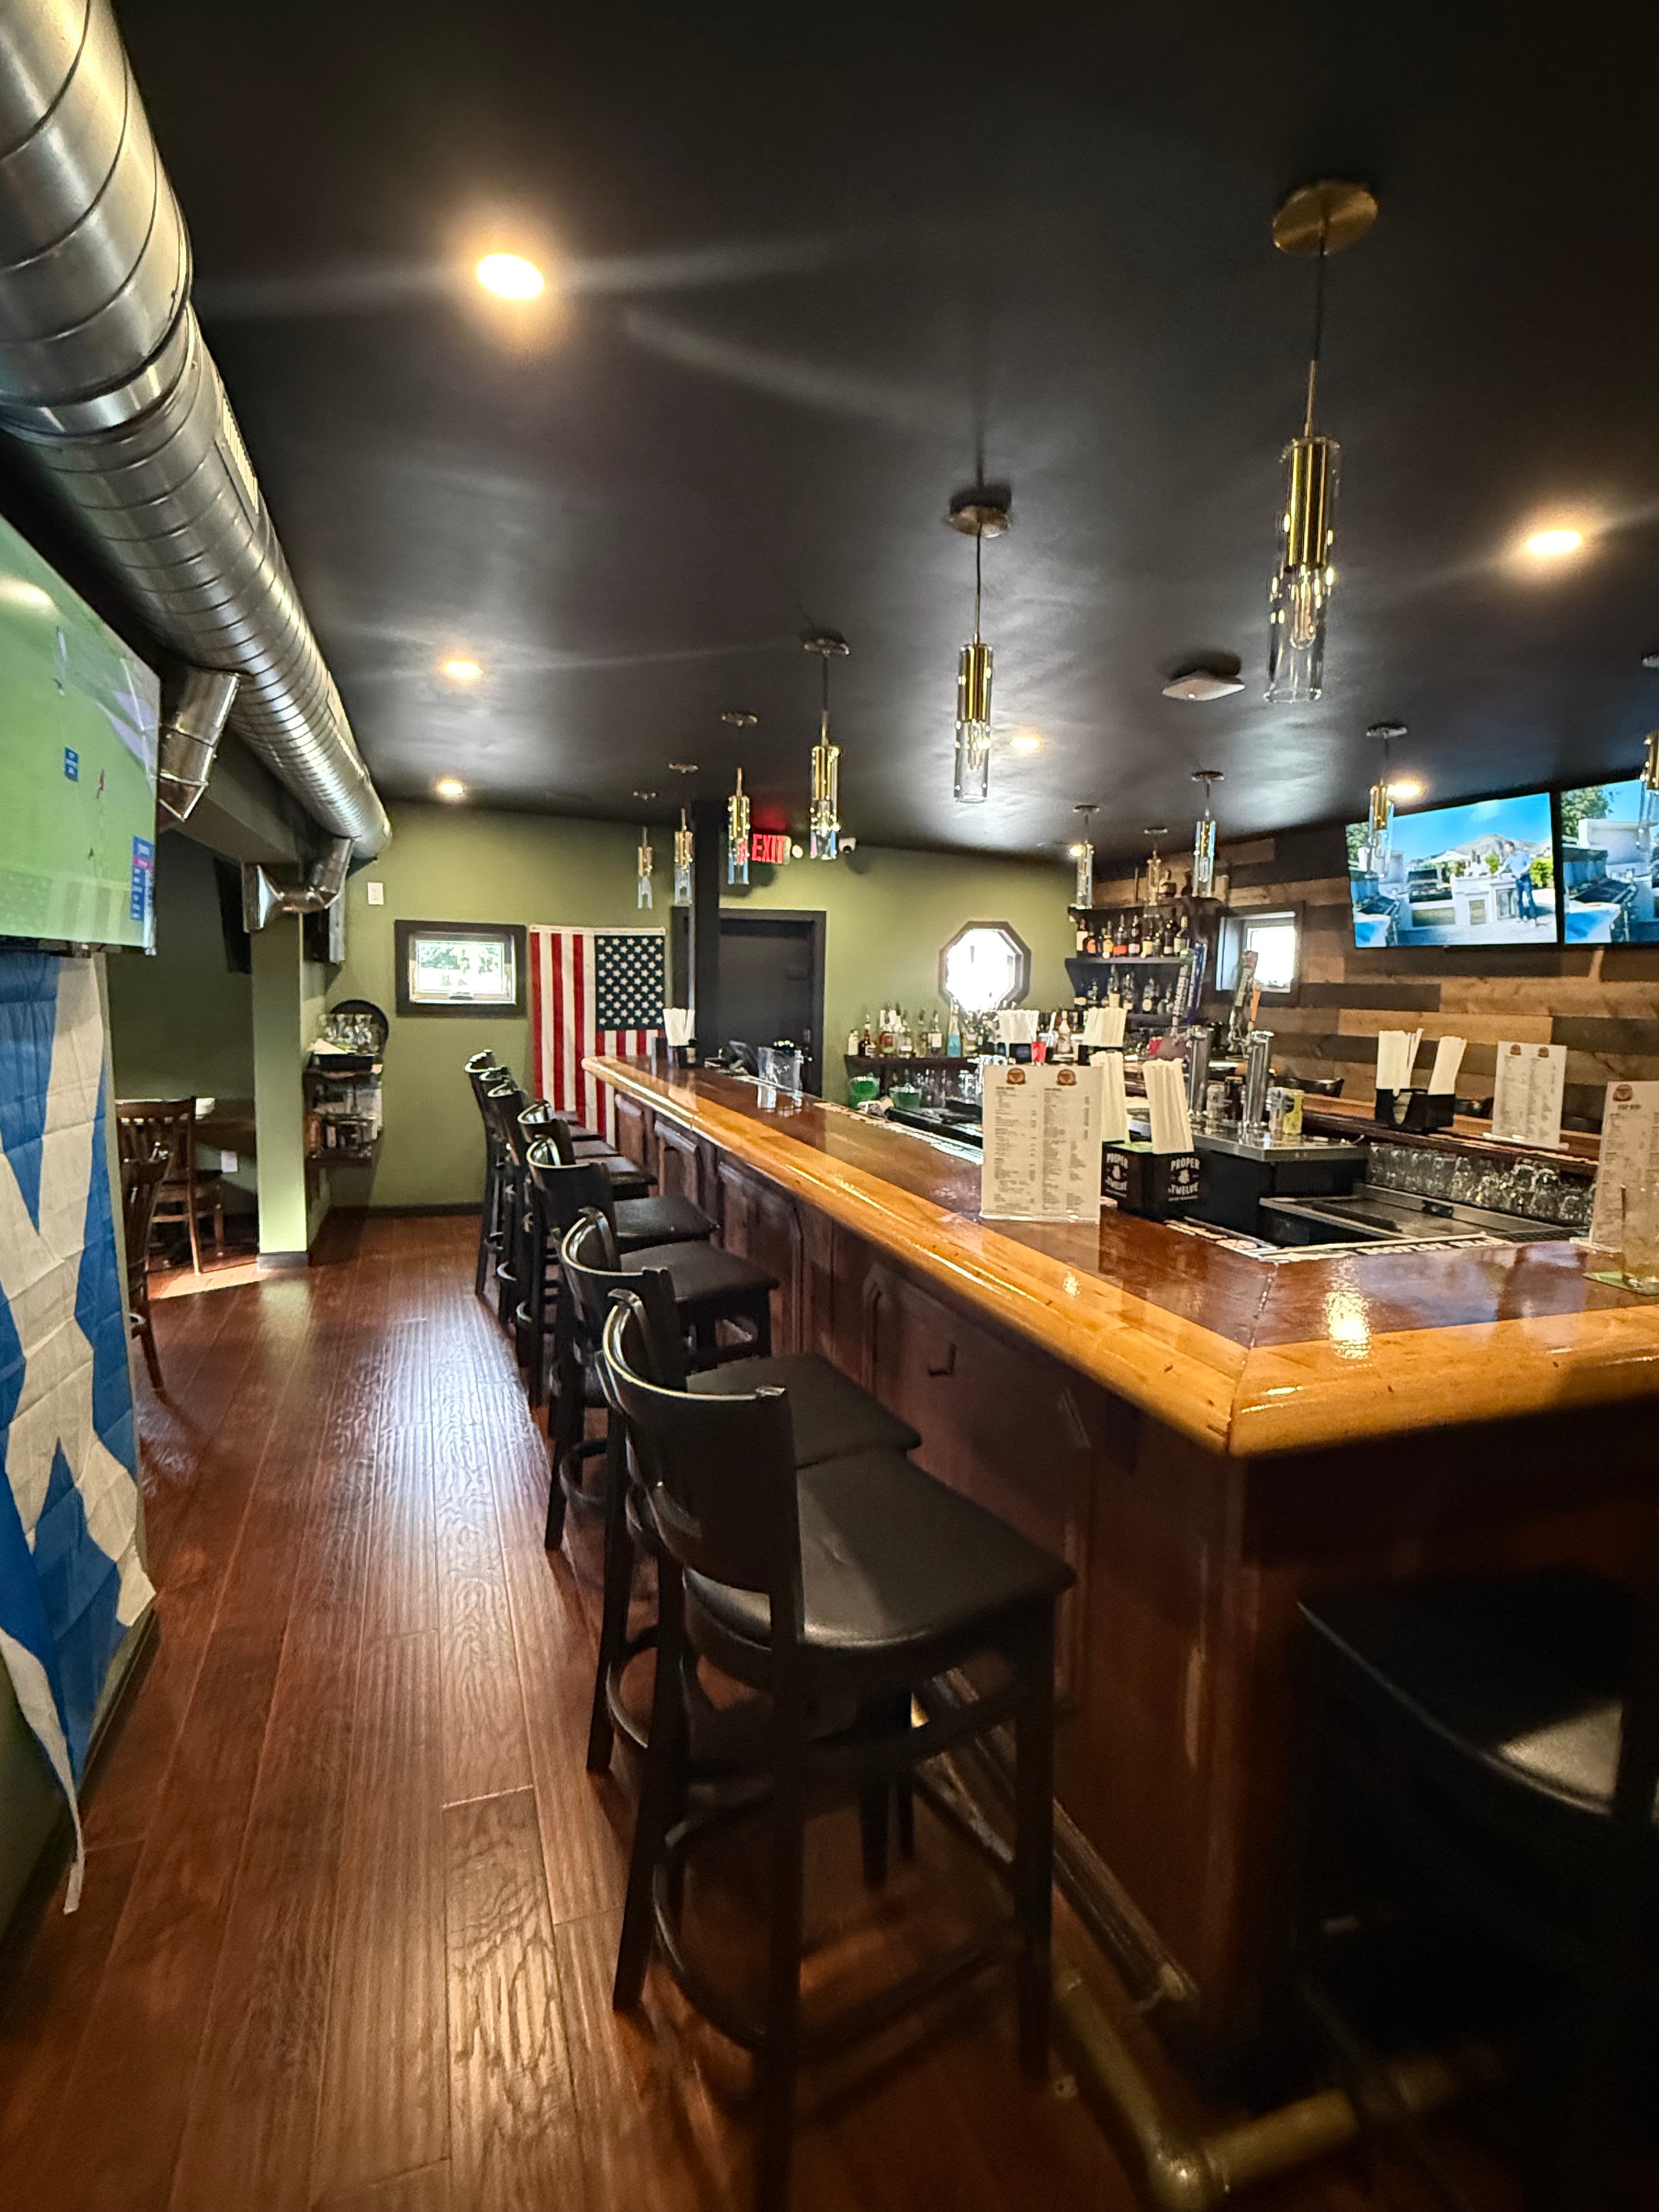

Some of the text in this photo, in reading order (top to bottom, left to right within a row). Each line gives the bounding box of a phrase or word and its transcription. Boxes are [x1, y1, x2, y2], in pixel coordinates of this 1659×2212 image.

[752, 834, 786, 863] EXIT
[1171, 1157, 1200, 1172] PROPER
[1171, 1182, 1199, 1195] TWELVE
